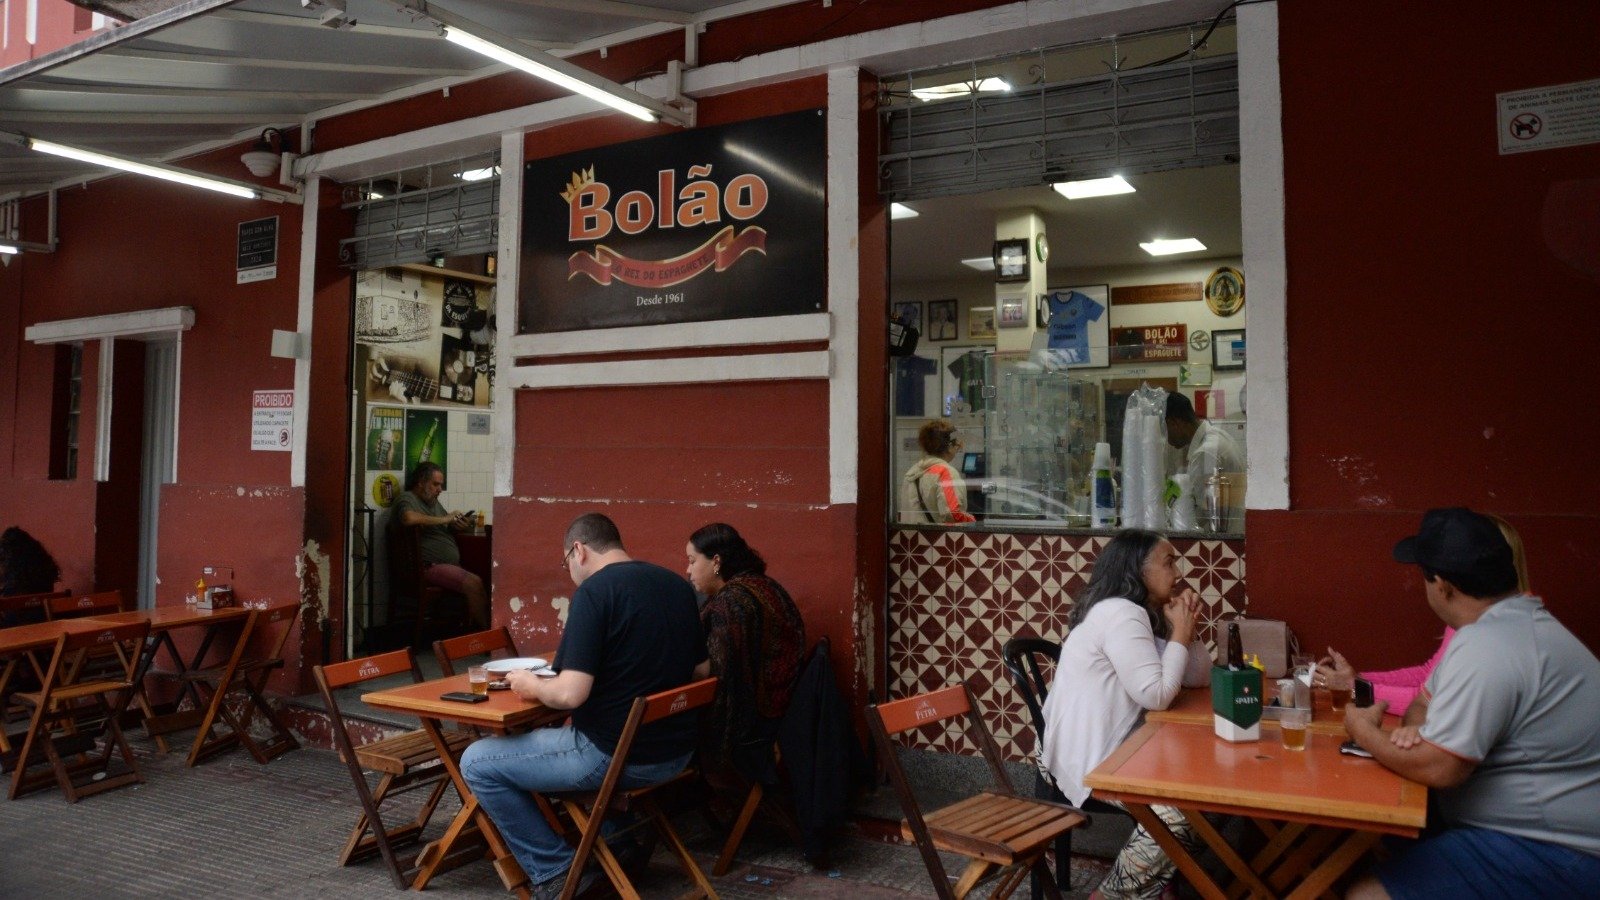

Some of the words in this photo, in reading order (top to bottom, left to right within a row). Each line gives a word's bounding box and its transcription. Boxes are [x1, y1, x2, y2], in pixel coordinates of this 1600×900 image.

[568, 164, 768, 242] Bolão
[642, 271, 655, 280] DO
[636, 294, 662, 306] Desde
[664, 293, 684, 304] 1961
[1144, 326, 1178, 340] BOLÃO
[1144, 348, 1182, 358] ESPAGUETE
[254, 394, 292, 406] PROIBIDO
[358, 666, 380, 677] PETRA
[1235, 696, 1258, 704] SPATEN
[915, 708, 937, 720] PETRA
